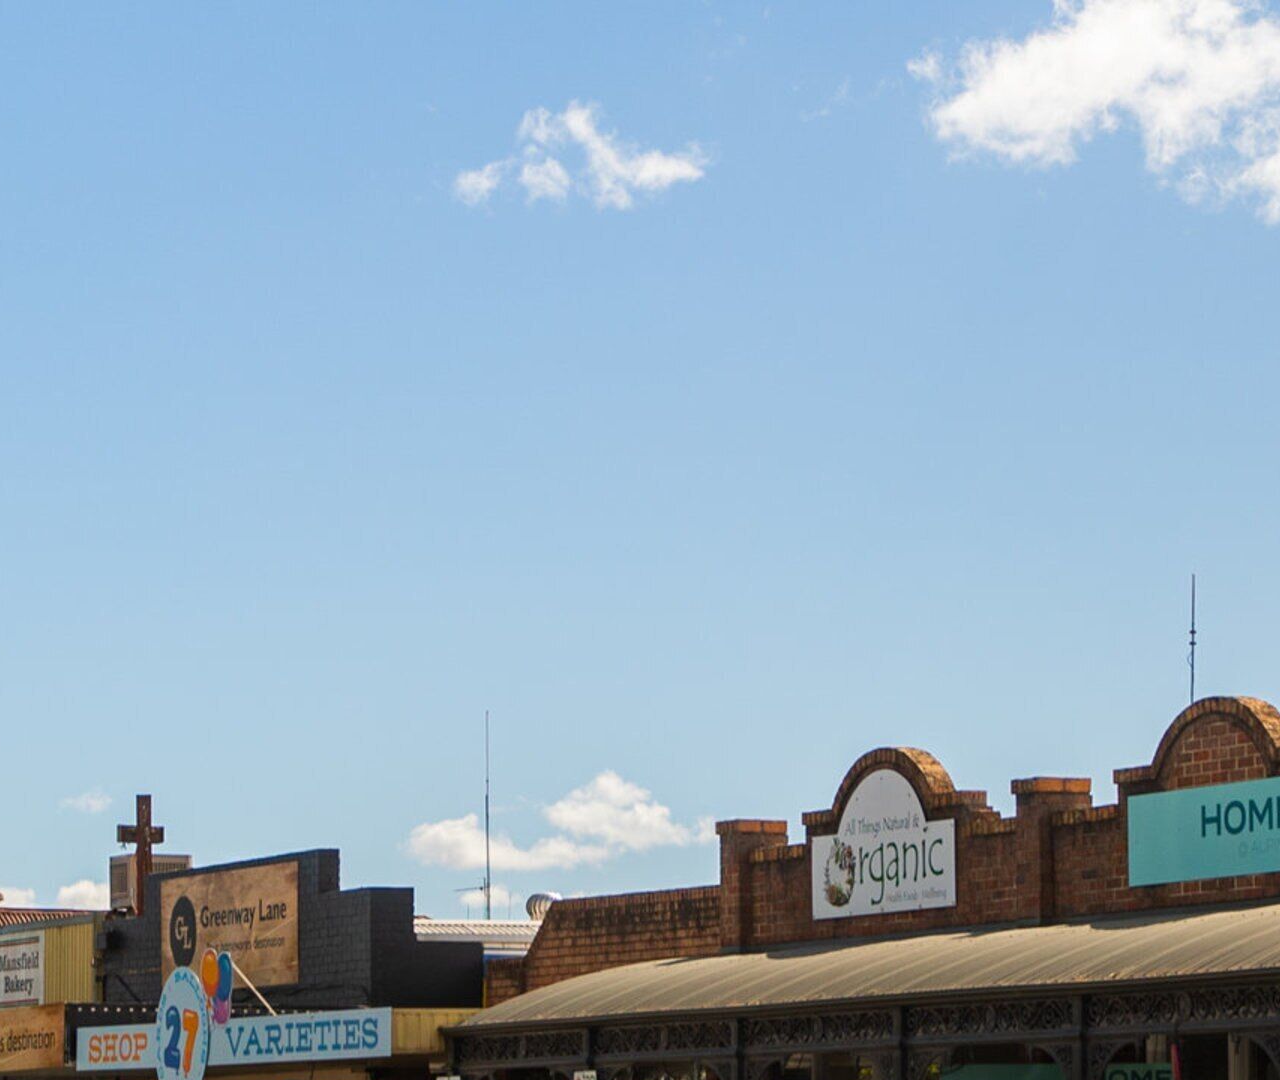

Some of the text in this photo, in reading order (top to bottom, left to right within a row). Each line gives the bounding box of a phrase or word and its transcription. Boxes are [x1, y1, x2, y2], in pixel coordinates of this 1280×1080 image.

[200, 898, 287, 929] Greenway Lane
[0, 951, 40, 972] Mansfield
[4, 975, 34, 996] Bakery
[6, 1029, 56, 1051] destination
[88, 1032, 148, 1064] SHOP
[164, 1006, 199, 1078] 27
[225, 1018, 379, 1056] VARIETIES
